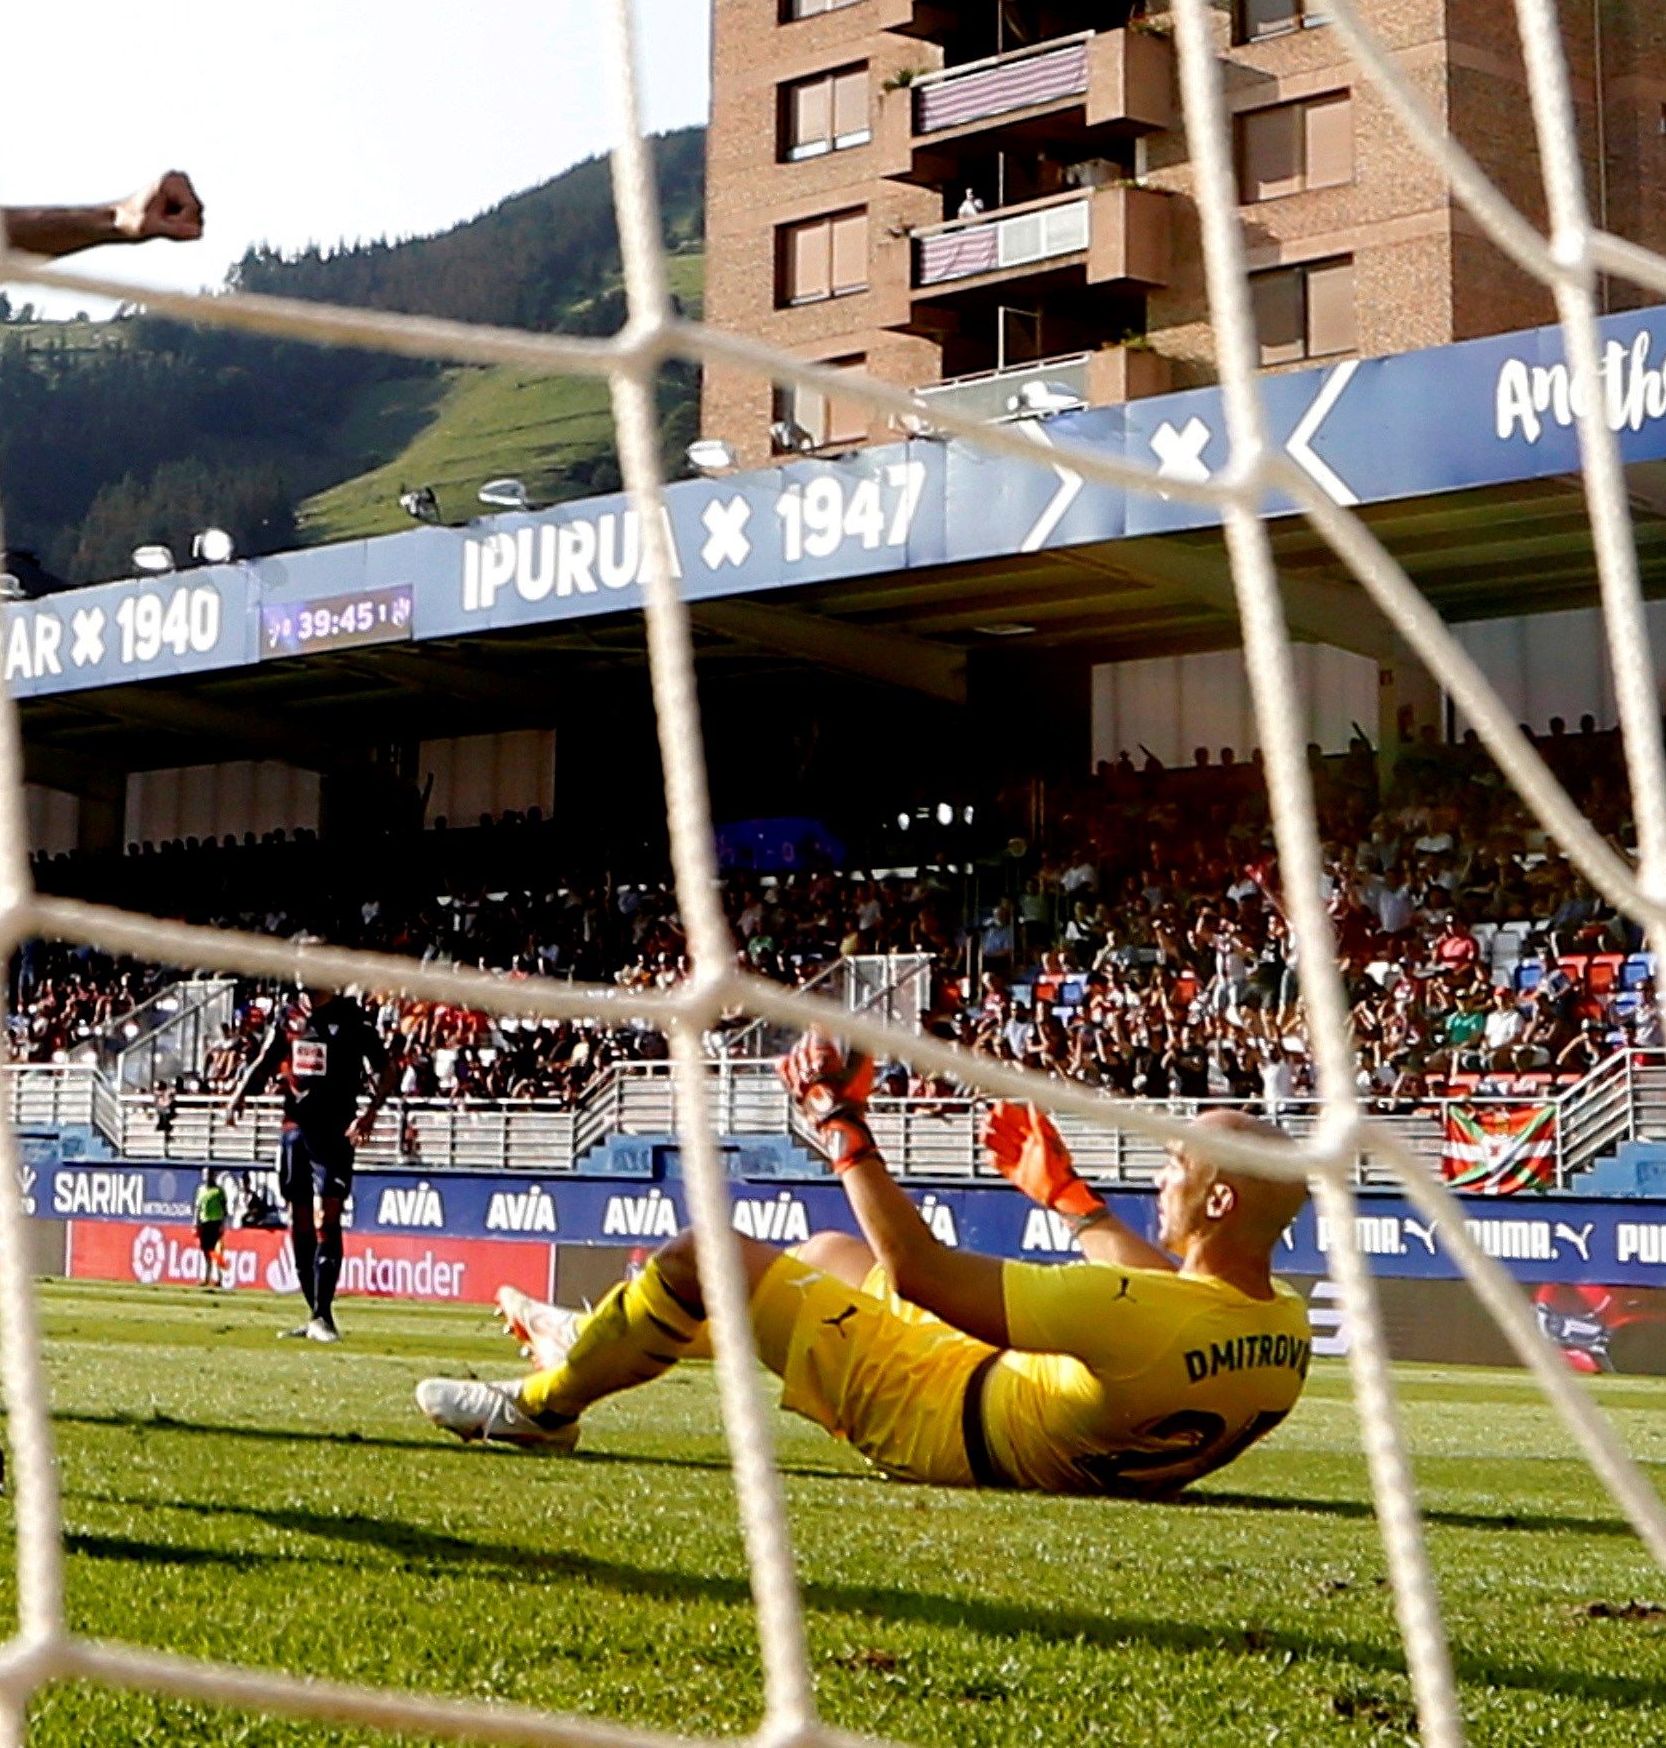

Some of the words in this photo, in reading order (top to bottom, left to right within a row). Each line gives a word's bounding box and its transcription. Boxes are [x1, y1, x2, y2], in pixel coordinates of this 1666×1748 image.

[463, 505, 682, 613] IPURUA
[775, 460, 927, 562] 1947
[116, 586, 220, 664] 1940
[298, 602, 374, 640] 39:45
[53, 1172, 143, 1215] SARIKI
[336, 1249, 465, 1296] antander
